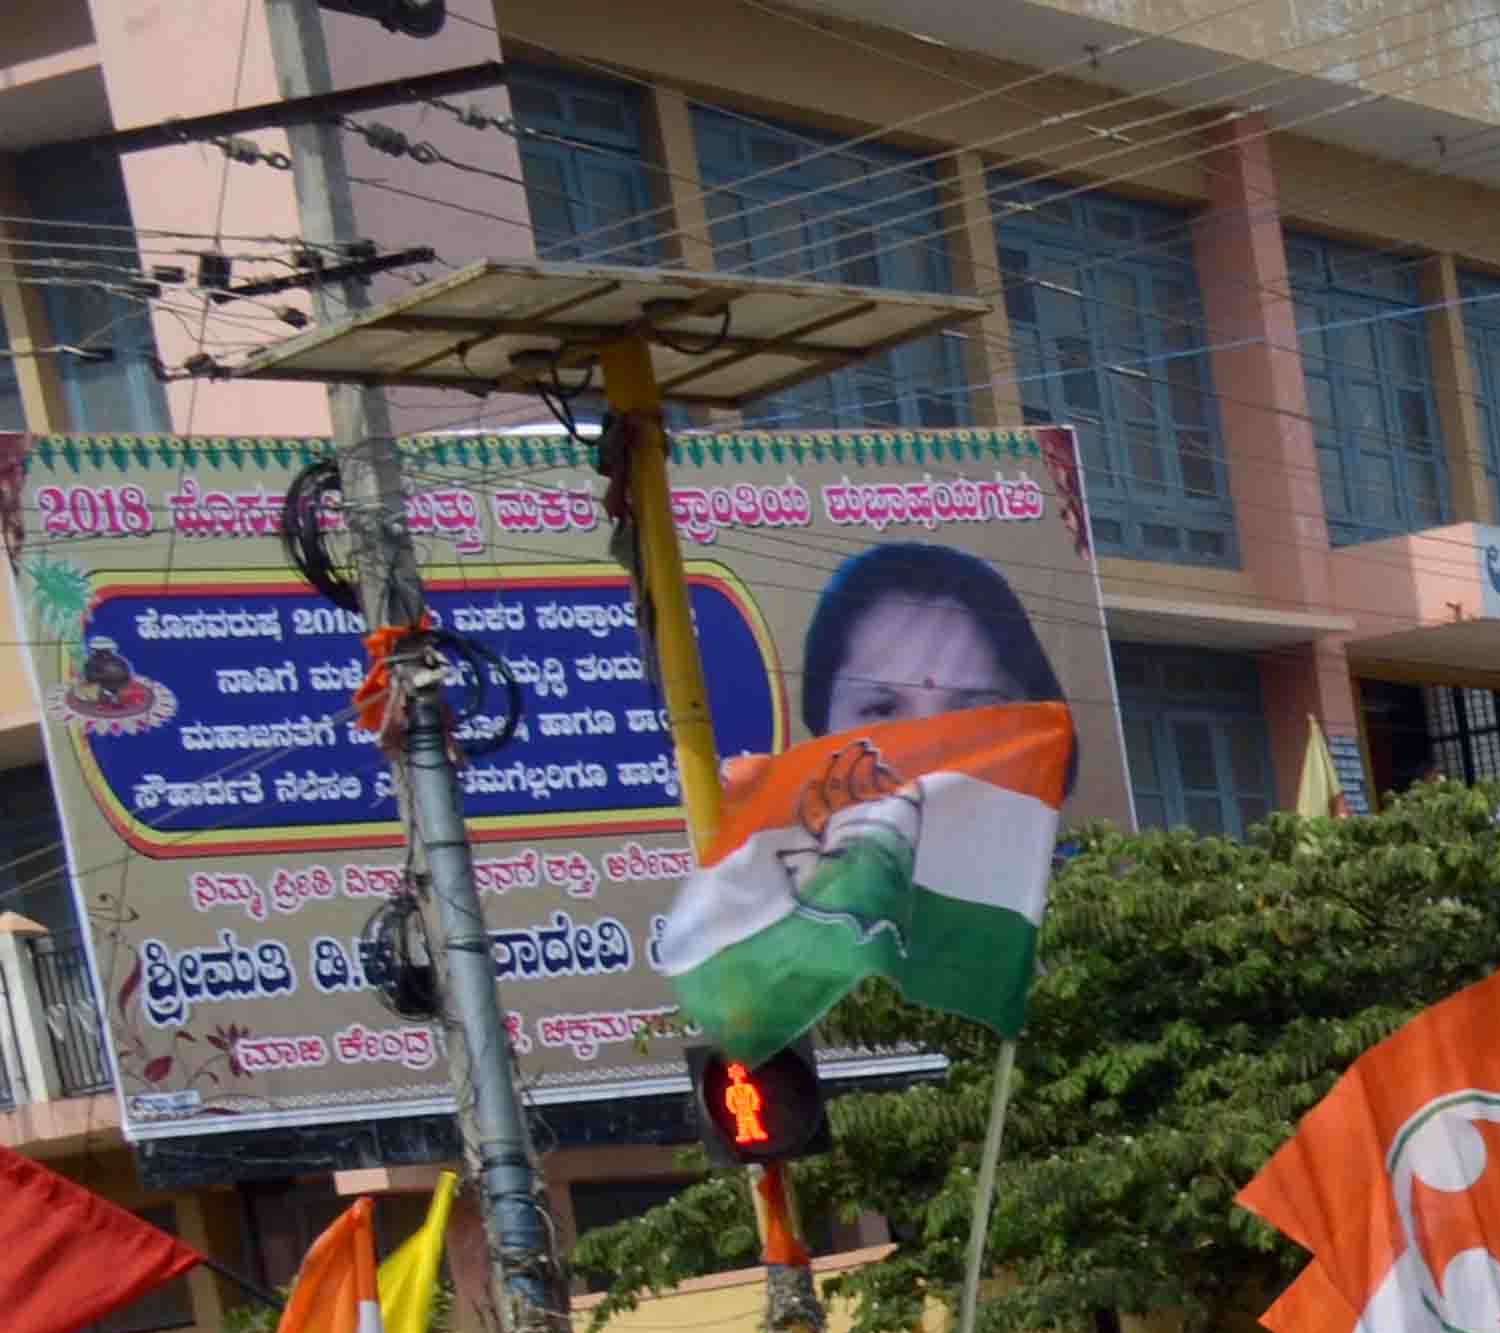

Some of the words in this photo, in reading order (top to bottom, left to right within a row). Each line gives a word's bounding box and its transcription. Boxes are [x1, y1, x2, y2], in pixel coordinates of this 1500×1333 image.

[37, 484, 153, 538] 2018
[495, 478, 600, 535] ಮಕರ
[134, 607, 284, 642] ಹೊಸವರುಷ
[452, 601, 526, 633] ಮಕರ
[192, 872, 264, 919] ನಿಮ್ಮ
[142, 929, 295, 1026] ಶ್ರೀಮತಿ
